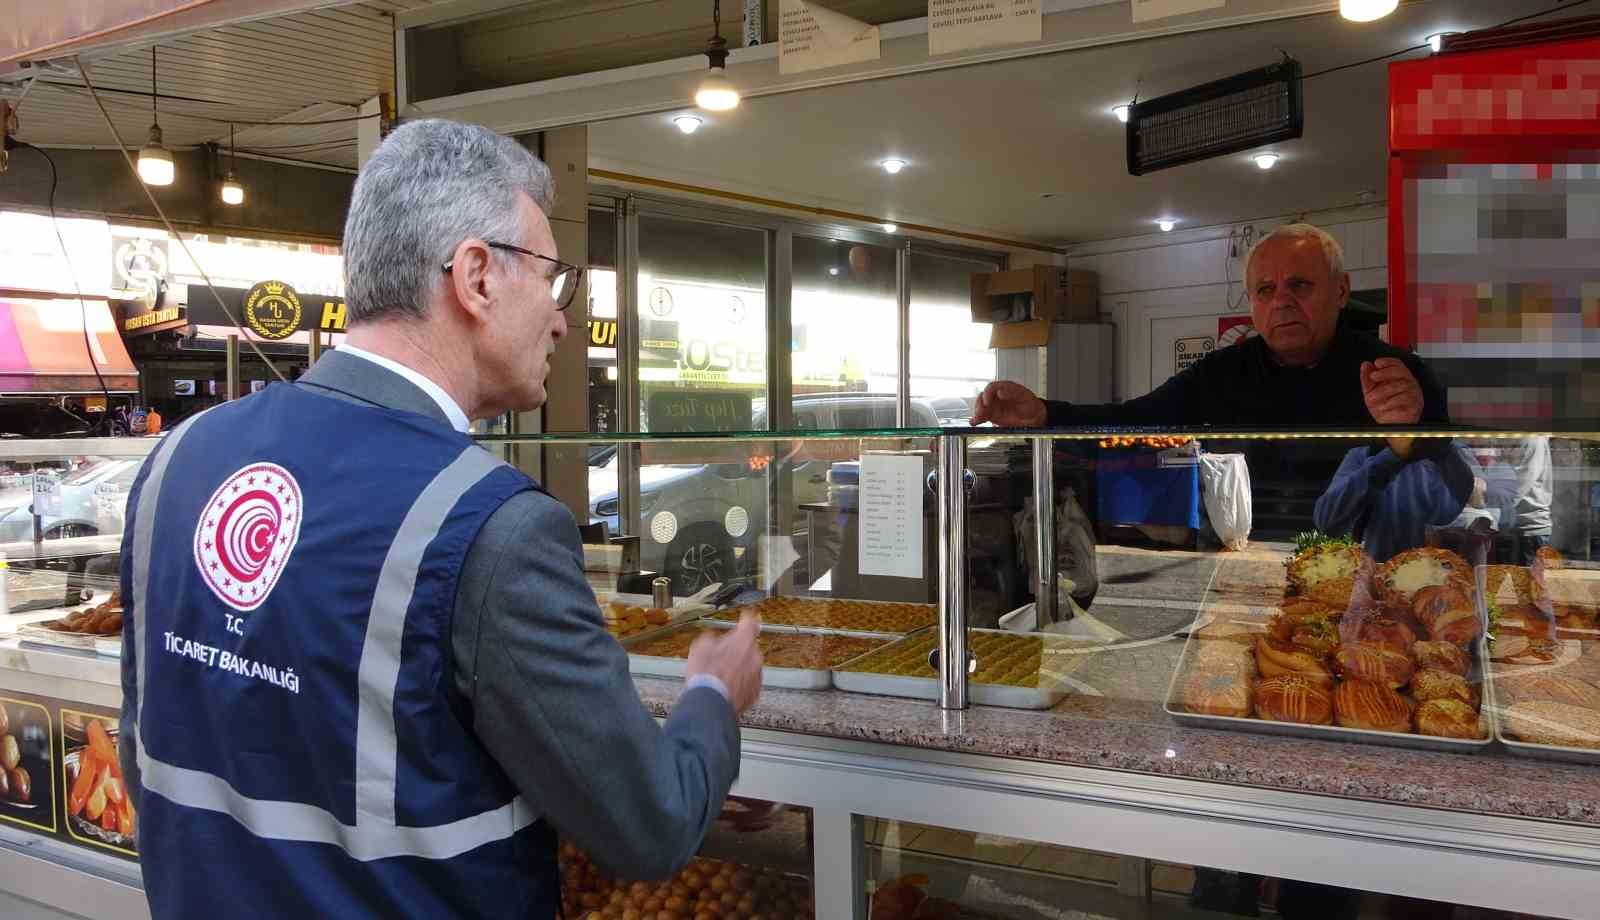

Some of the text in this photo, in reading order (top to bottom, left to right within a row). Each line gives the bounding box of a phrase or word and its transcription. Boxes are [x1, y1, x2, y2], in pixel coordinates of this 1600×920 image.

[225, 613, 244, 636] T.C.
[164, 631, 299, 694] TİCARET BAKANLIĞI
